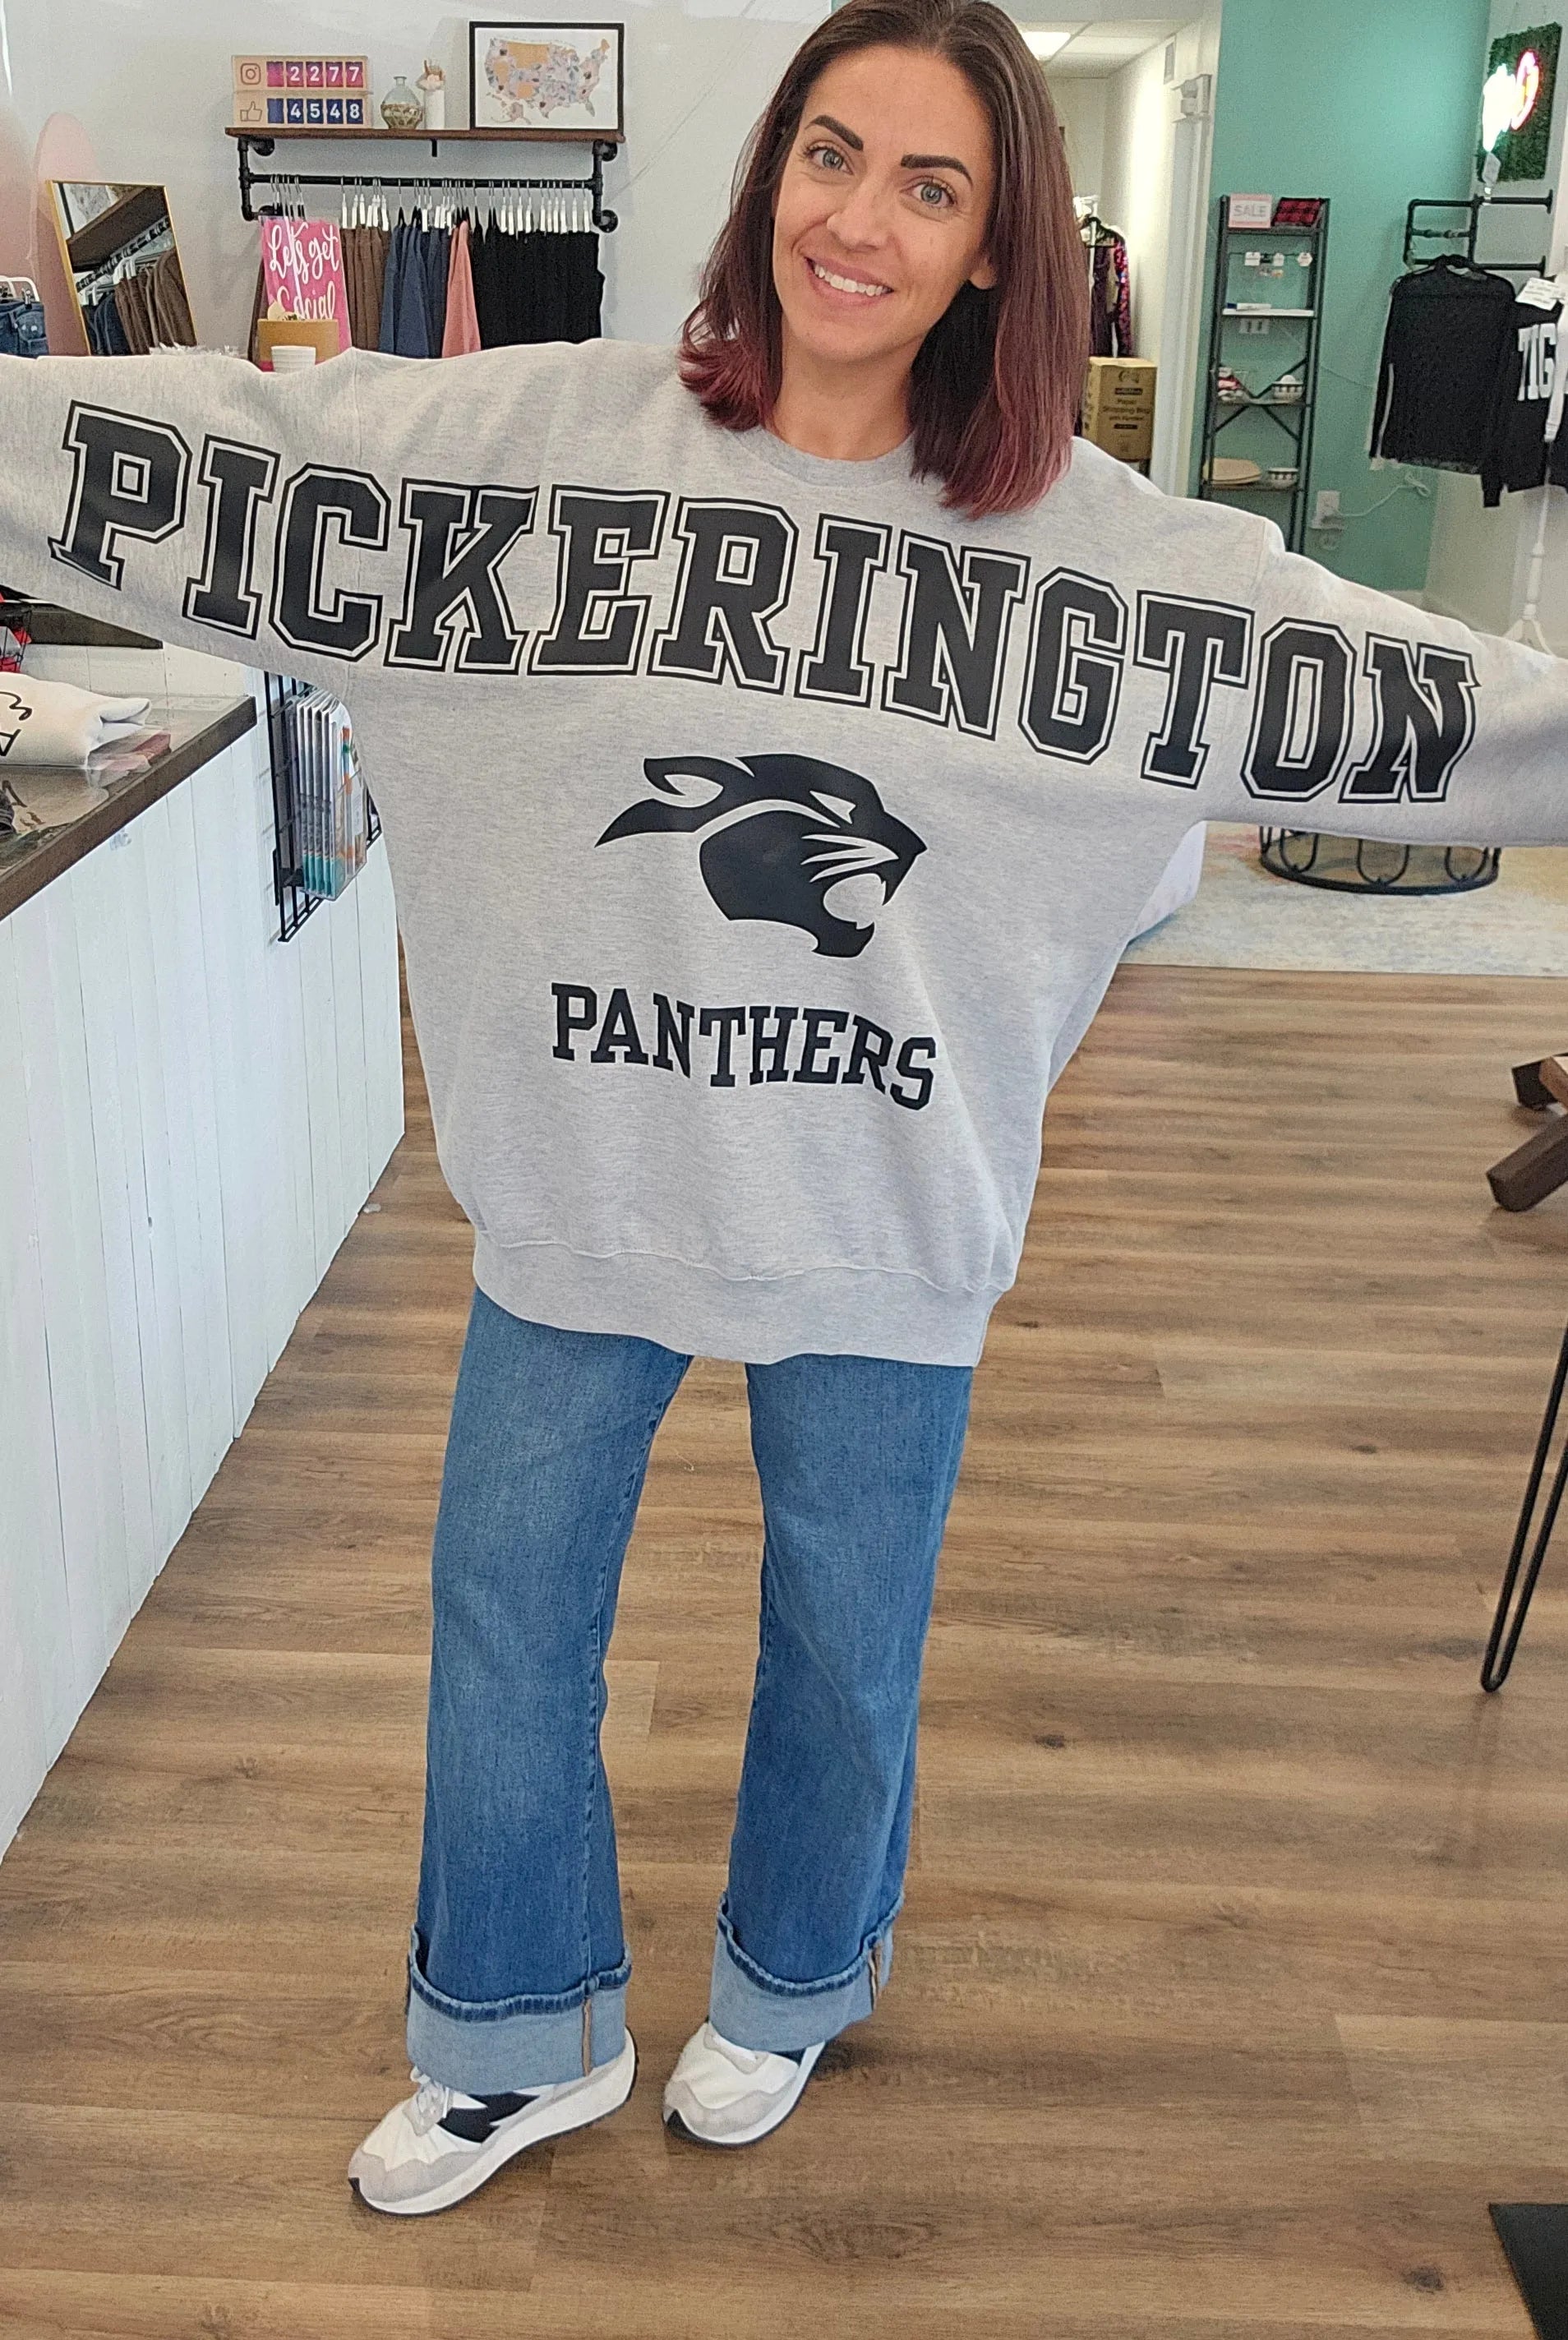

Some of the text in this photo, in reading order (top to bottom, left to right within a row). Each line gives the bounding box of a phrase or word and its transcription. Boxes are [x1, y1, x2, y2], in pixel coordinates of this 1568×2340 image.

[289, 66, 360, 82] 2277
[289, 103, 361, 119] 4548
[1234, 204, 1269, 217] SALE
[308, 224, 339, 280] get
[47, 399, 1482, 805] PICKERINGTON
[551, 981, 937, 1111] PANTHERS
